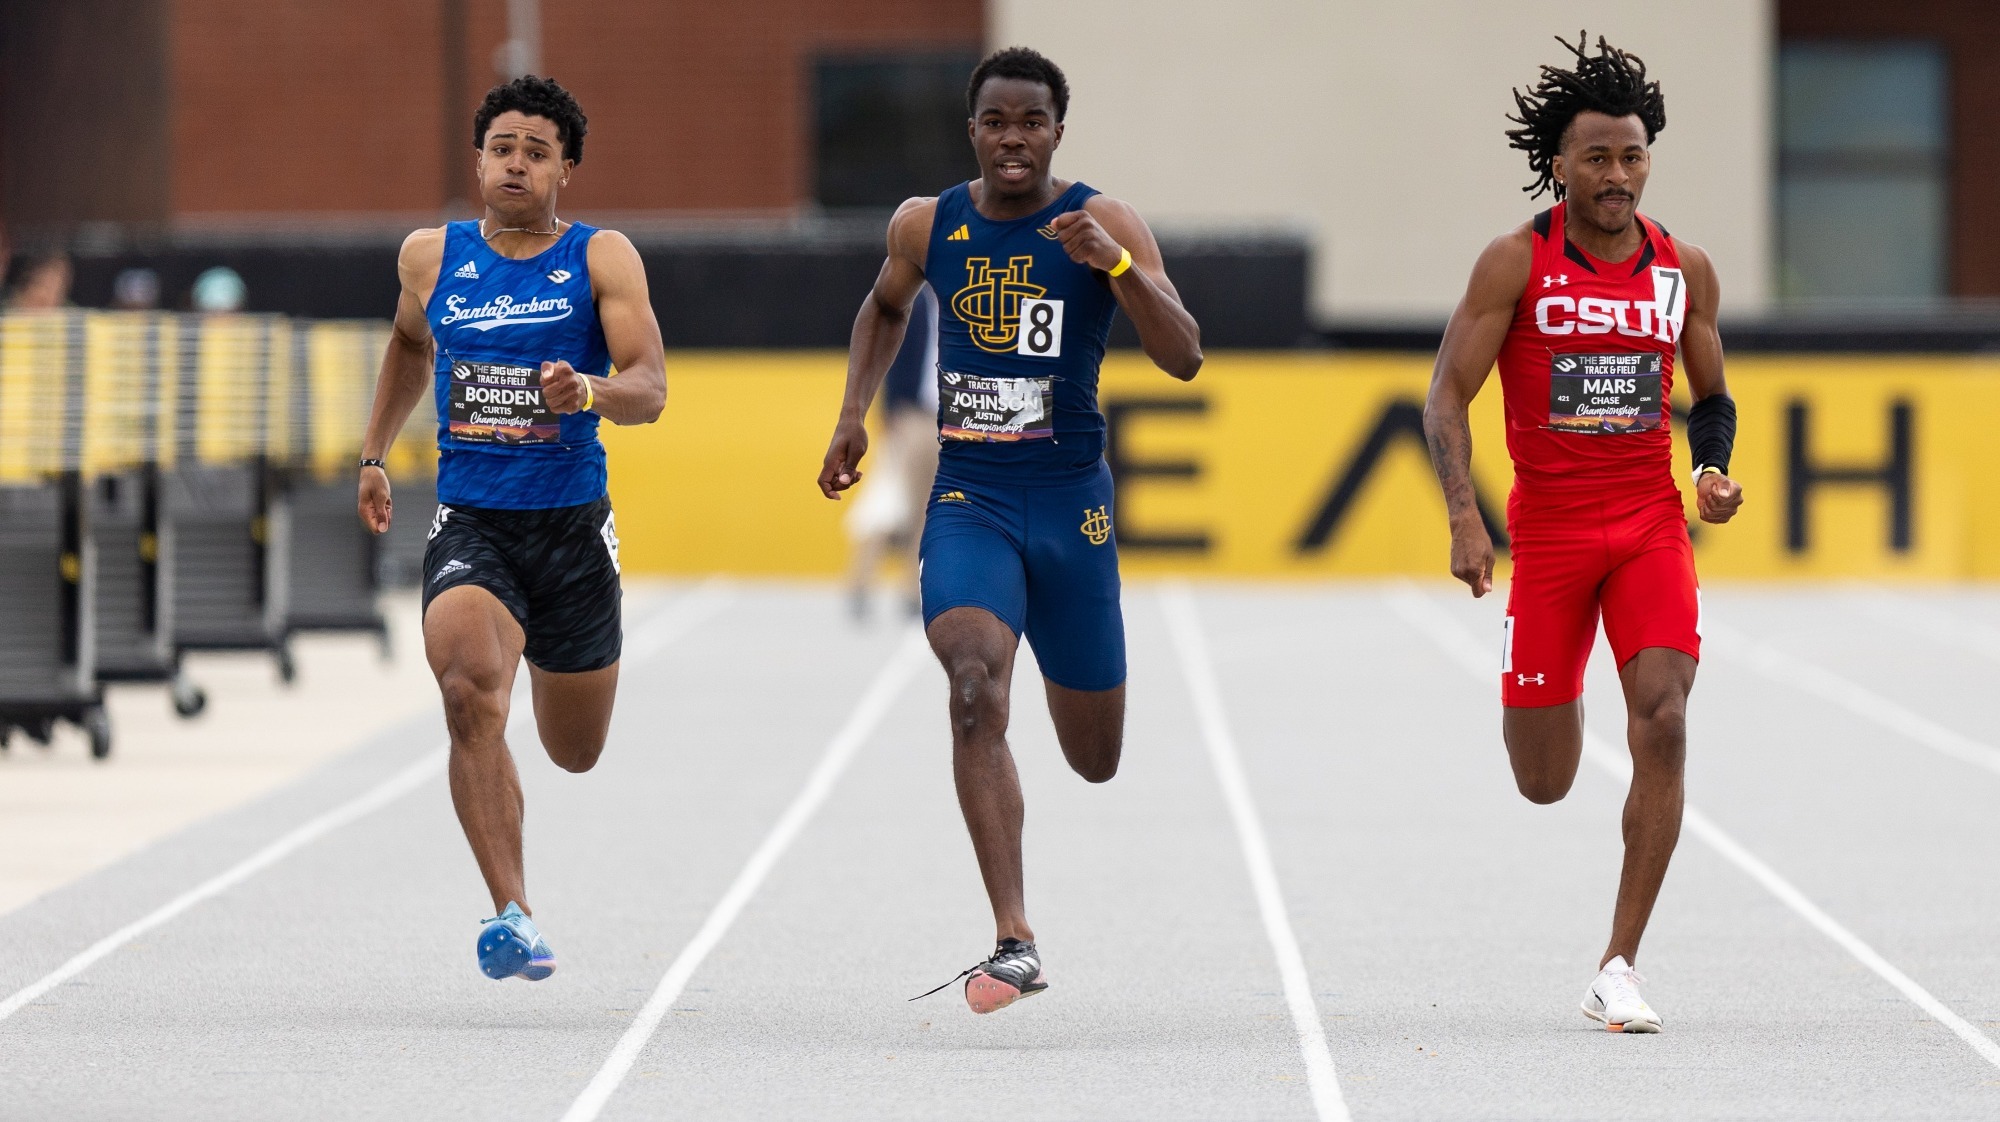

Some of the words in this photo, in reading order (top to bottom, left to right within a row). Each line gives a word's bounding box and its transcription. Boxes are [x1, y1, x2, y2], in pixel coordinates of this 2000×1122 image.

[454, 271, 479, 280] adidas
[1659, 270, 1680, 316] 7
[1027, 302, 1054, 353] 8
[1578, 356, 1598, 365] THE
[1616, 356, 1641, 364] WEST
[472, 364, 489, 374] THE
[506, 368, 532, 377] WEST
[1584, 365, 1608, 374] TRACK
[1610, 365, 1616, 374] &
[1616, 366, 1636, 374] FIELD
[477, 374, 500, 384] TRACK
[506, 376, 526, 386] FIELD
[968, 380, 991, 390] TRACK
[992, 382, 998, 390] &
[1583, 378, 1636, 394] MARS
[465, 386, 540, 406] BORDEN
[952, 391, 1038, 412] JOHNSON
[1590, 396, 1620, 405] CHASE
[482, 406, 512, 415] CURTIS
[974, 412, 1003, 422] JUSTIN
[1576, 403, 1640, 418] Championships
[470, 412, 533, 428] Championships
[962, 416, 1025, 434] Championships
